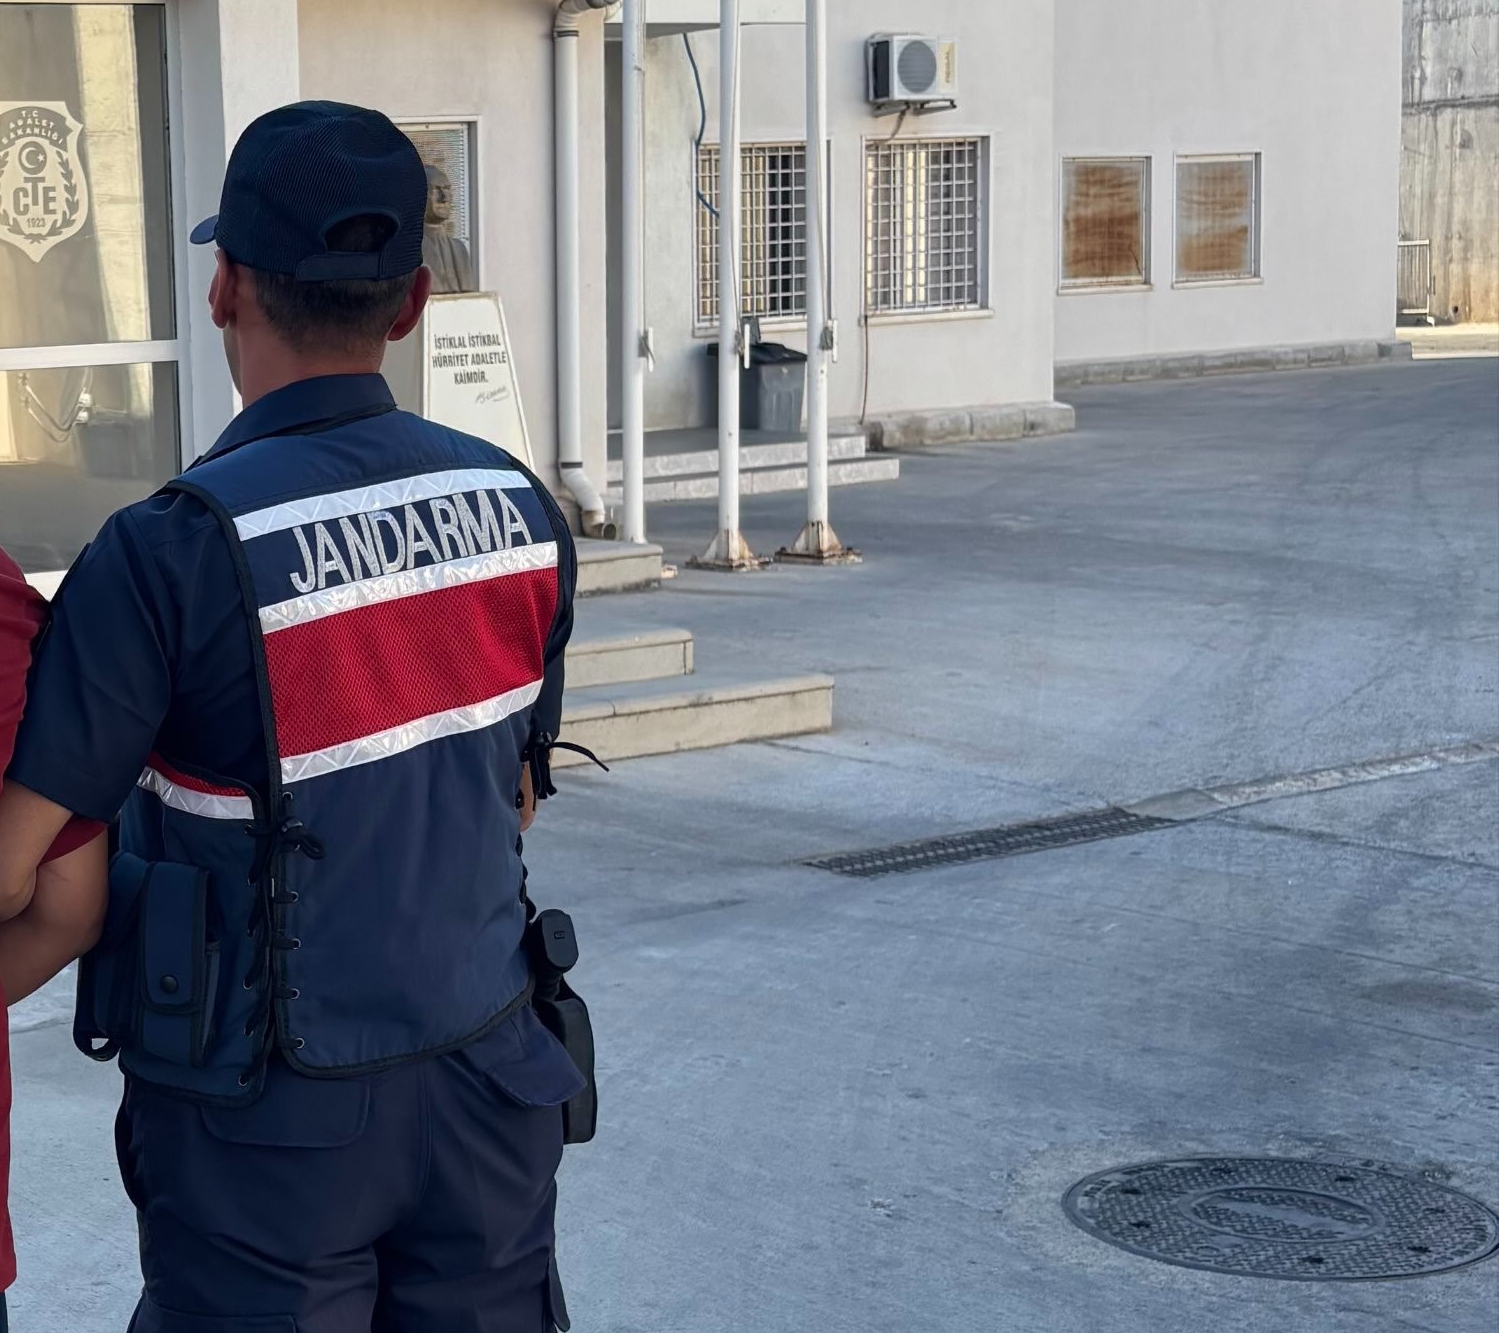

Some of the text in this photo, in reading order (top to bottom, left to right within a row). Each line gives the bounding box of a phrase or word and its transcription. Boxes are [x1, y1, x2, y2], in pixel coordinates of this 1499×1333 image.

[9, 118, 55, 130] ADALET
[12, 176, 57, 216] CTE
[26, 217, 46, 228] 1923
[433, 331, 501, 350] İSTİKLAL İSTİKBAL
[432, 351, 507, 368] HÜRRİYET ADALETLE
[290, 489, 533, 594] JANDARMA
